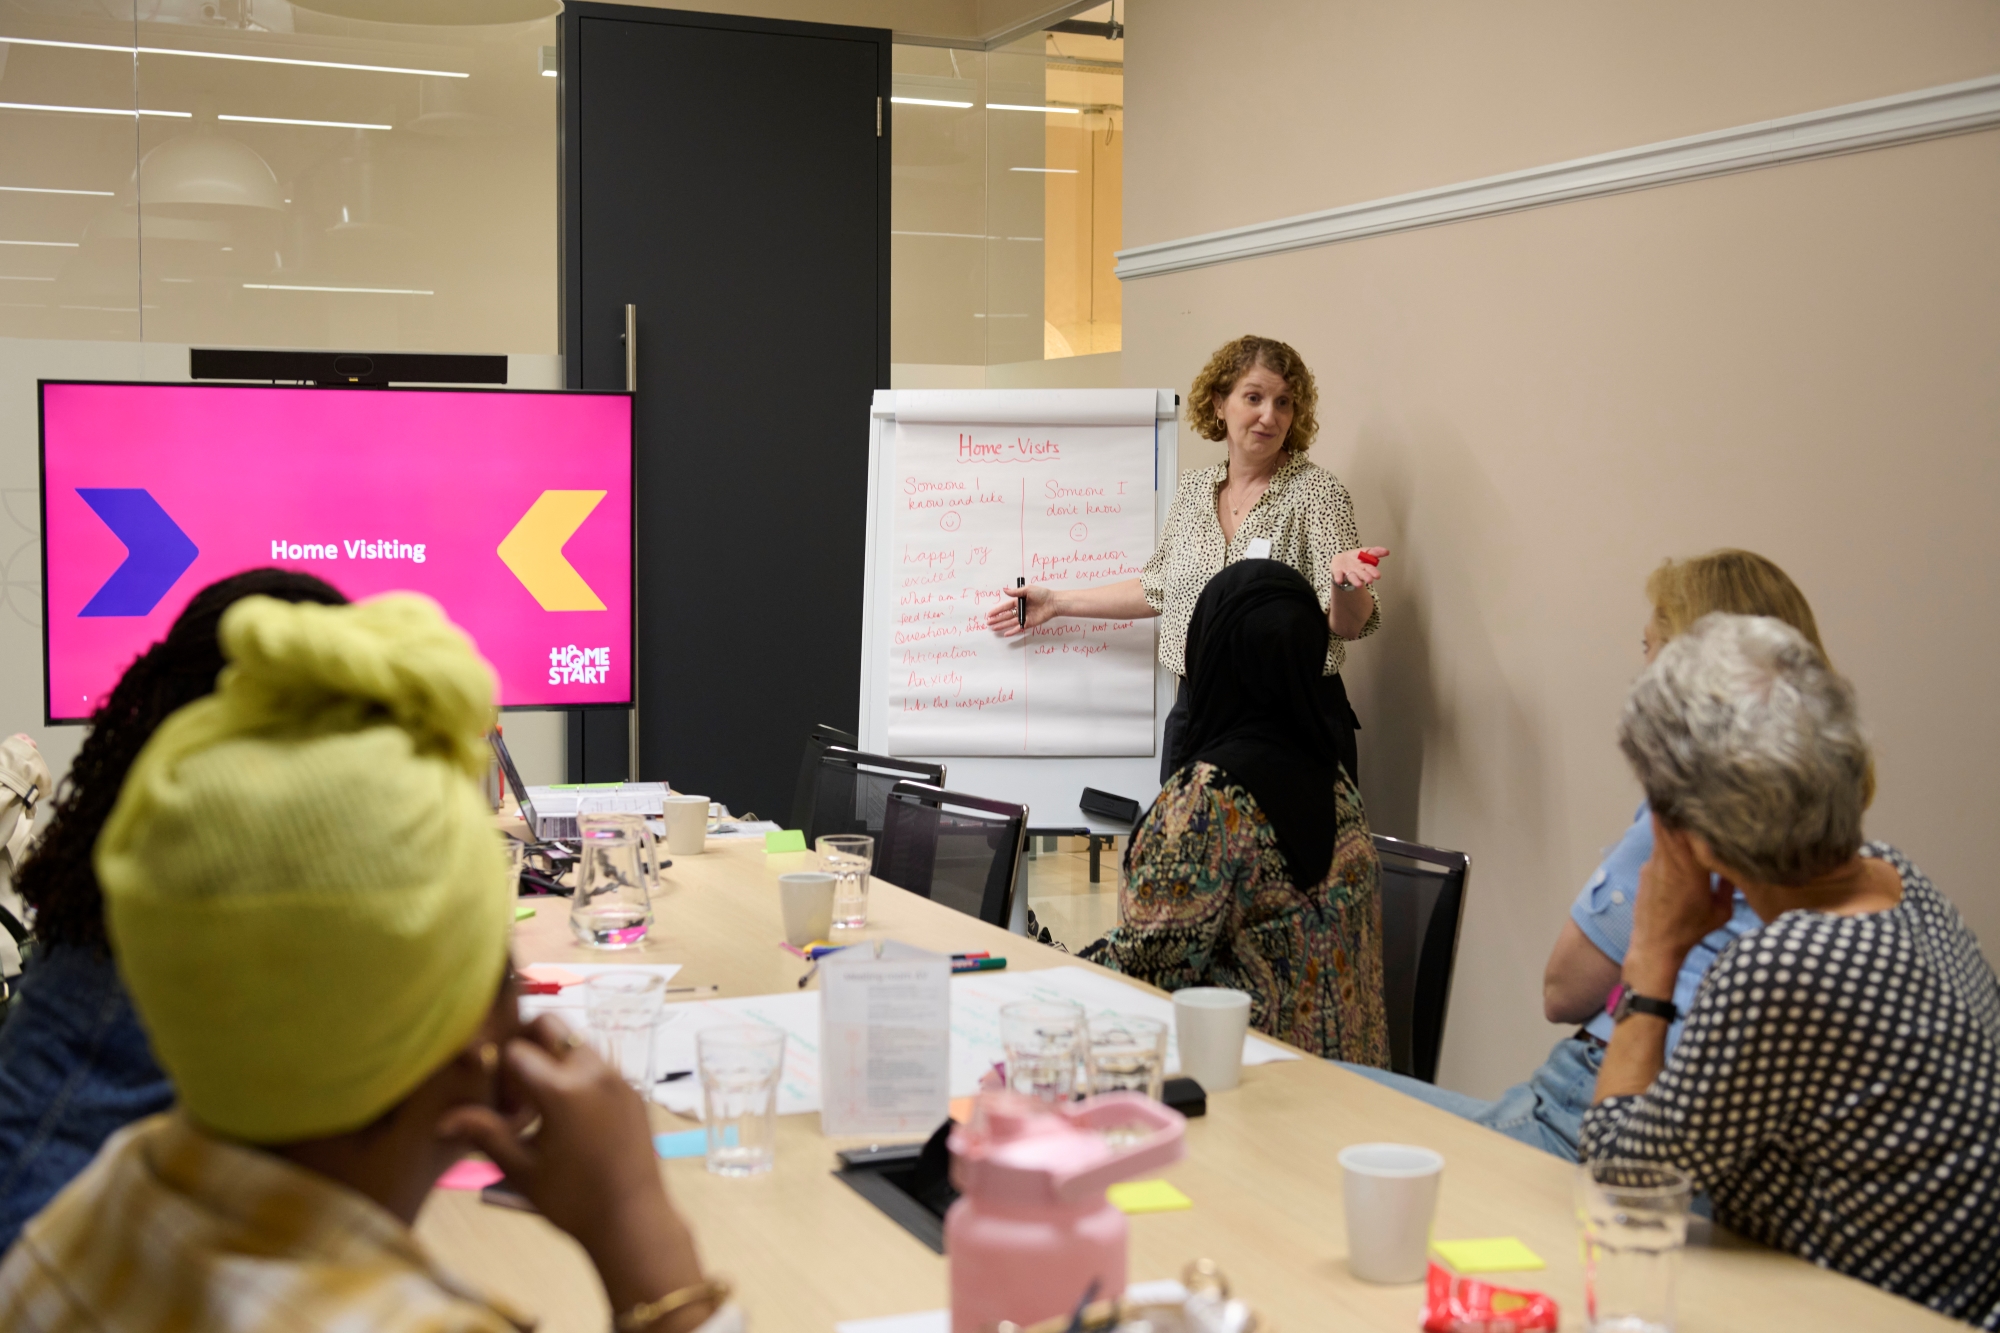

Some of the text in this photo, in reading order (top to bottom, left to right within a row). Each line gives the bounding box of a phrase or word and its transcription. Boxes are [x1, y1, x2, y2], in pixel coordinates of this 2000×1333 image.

[958, 433, 1003, 457] Home
[1017, 437, 1060, 455] Visits
[904, 476, 966, 495] Someone
[1045, 479, 1129, 499] Someone I
[908, 491, 1005, 510] know and like
[1046, 502, 1122, 516] don't know
[270, 539, 426, 564] Home Visiting
[903, 544, 992, 570] happy joy
[1031, 550, 1128, 570] Apprehension
[902, 569, 956, 588] excited
[1030, 564, 1145, 583] about expectation
[900, 591, 934, 606] What
[938, 594, 957, 602] am
[960, 587, 975, 599] I
[974, 587, 1001, 605] going
[897, 613, 920, 626] feed
[1091, 622, 1108, 632] not
[1113, 621, 1134, 631] sure
[548, 644, 611, 668] HOME
[1035, 645, 1056, 655] what
[1073, 642, 1109, 657] expect
[548, 665, 611, 685] START
[907, 670, 963, 698] Anxiety
[933, 695, 949, 708] the
[955, 687, 1014, 710] unexpected
